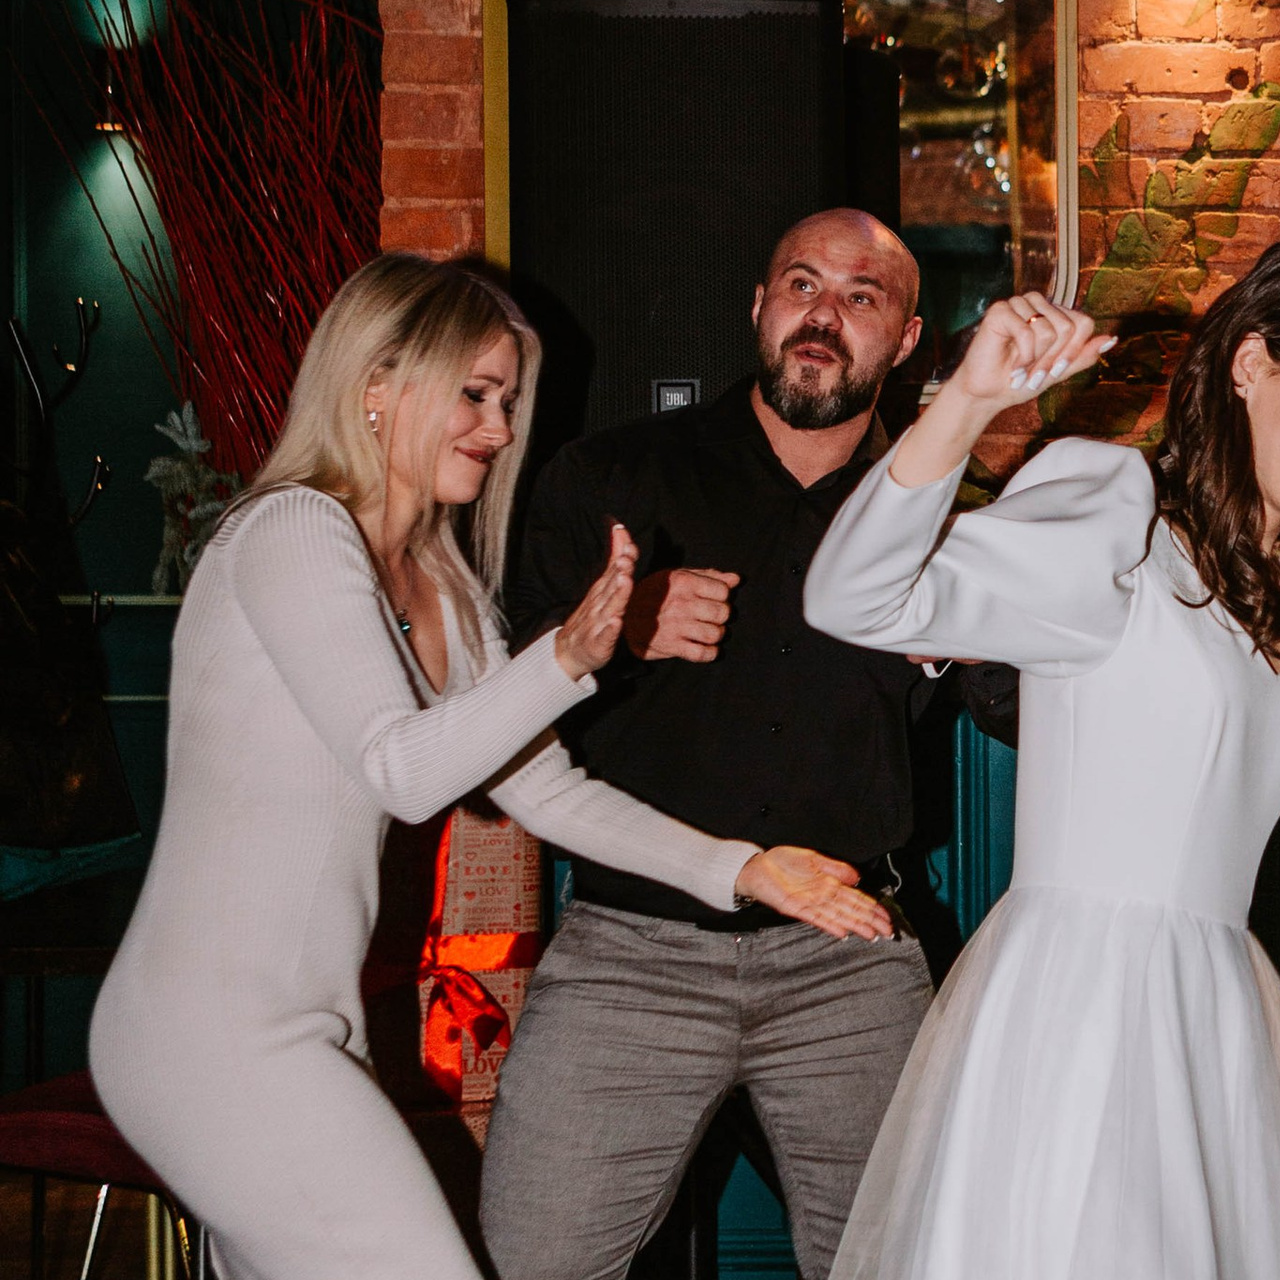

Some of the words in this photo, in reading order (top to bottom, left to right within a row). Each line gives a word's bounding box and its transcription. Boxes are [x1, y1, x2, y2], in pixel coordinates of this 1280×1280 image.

[666, 393, 688, 406] JBL
[464, 866, 511, 876] LOVE
[479, 886, 510, 896] LOVE
[462, 1057, 505, 1074] LOV
